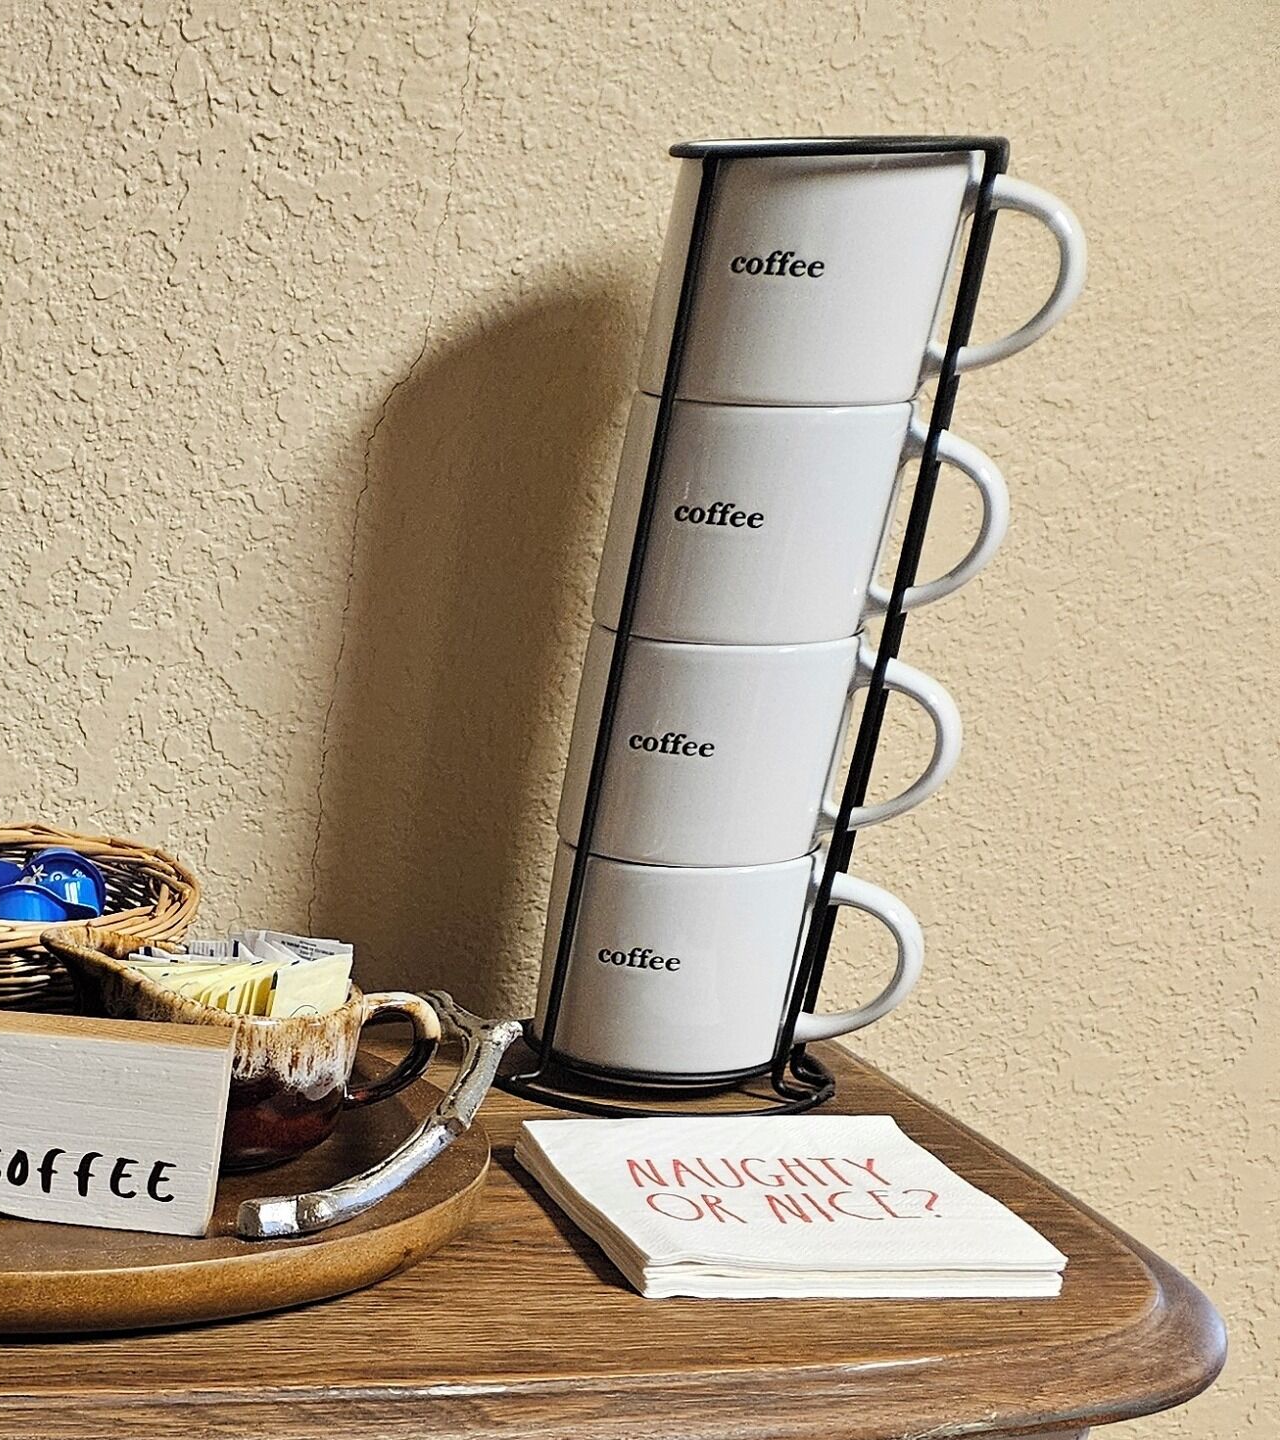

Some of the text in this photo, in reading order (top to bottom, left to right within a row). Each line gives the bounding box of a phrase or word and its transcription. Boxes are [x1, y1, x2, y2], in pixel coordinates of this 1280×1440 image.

[730, 250, 826, 280] coffee
[673, 501, 765, 531] coffee
[628, 730, 716, 760] coffee
[597, 943, 682, 974] coffee
[626, 1157, 892, 1189] NAUGHTY
[645, 1188, 943, 1225] OR NICE?
